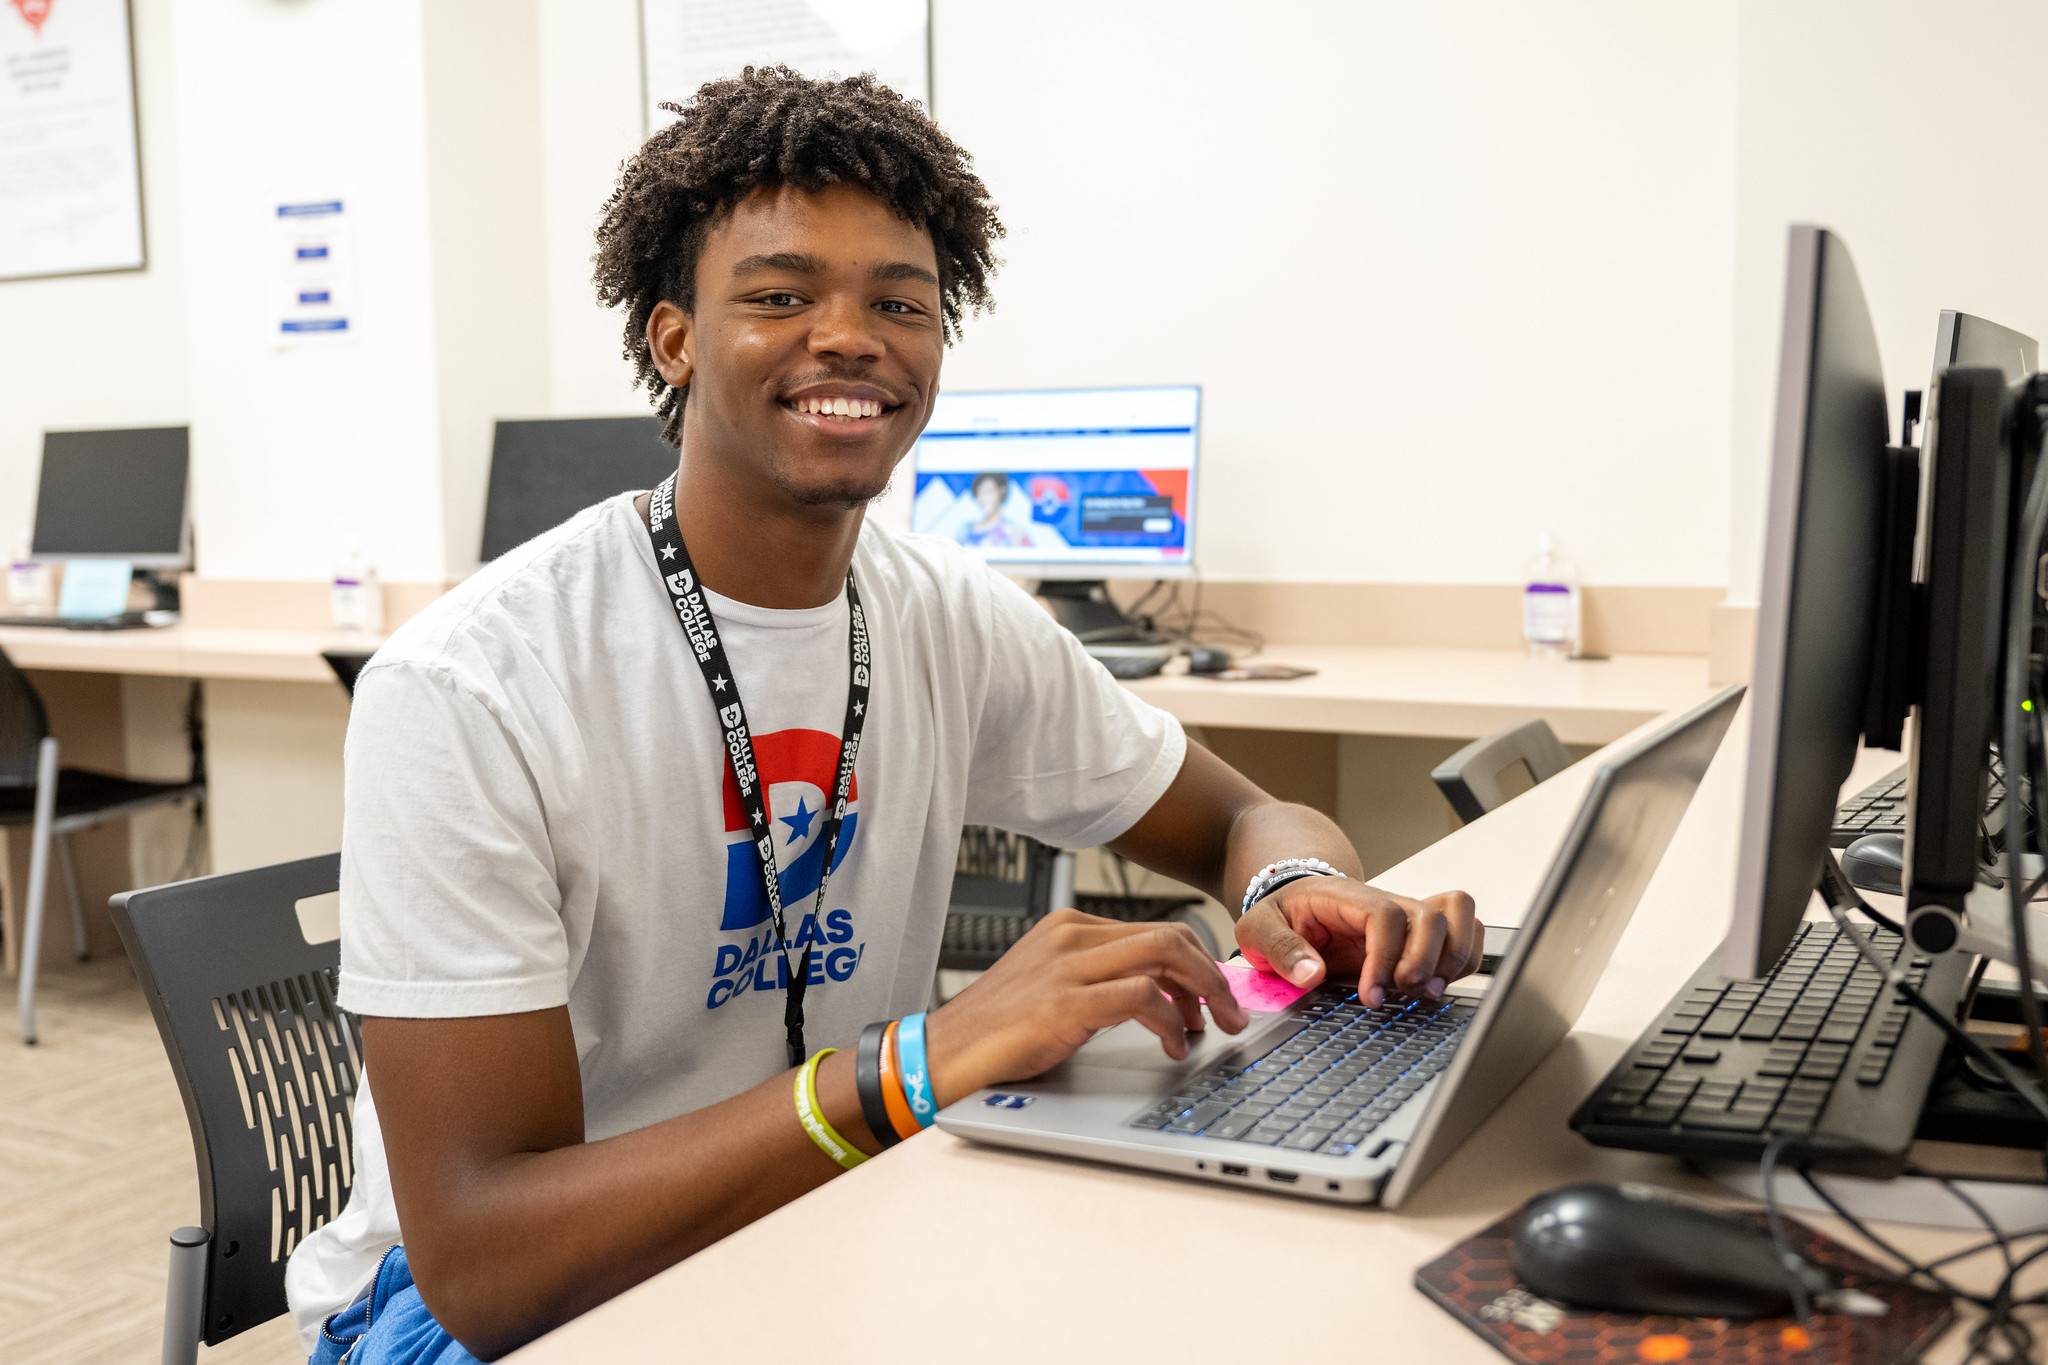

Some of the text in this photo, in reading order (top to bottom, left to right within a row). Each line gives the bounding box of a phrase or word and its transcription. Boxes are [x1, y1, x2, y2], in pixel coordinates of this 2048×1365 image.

[650, 487, 664, 533] COLLEGE
[675, 597, 711, 663] COLLEGE
[686, 592, 718, 649] DALLAS
[854, 604, 870, 664] COLLEGE
[726, 731, 752, 797] COLLEGE
[735, 725, 757, 783] DALLAS
[838, 741, 852, 796] DALLAS
[843, 733, 860, 797] COLLEGE
[713, 909, 854, 977] DALLAS
[707, 943, 865, 1009] COLLEG
